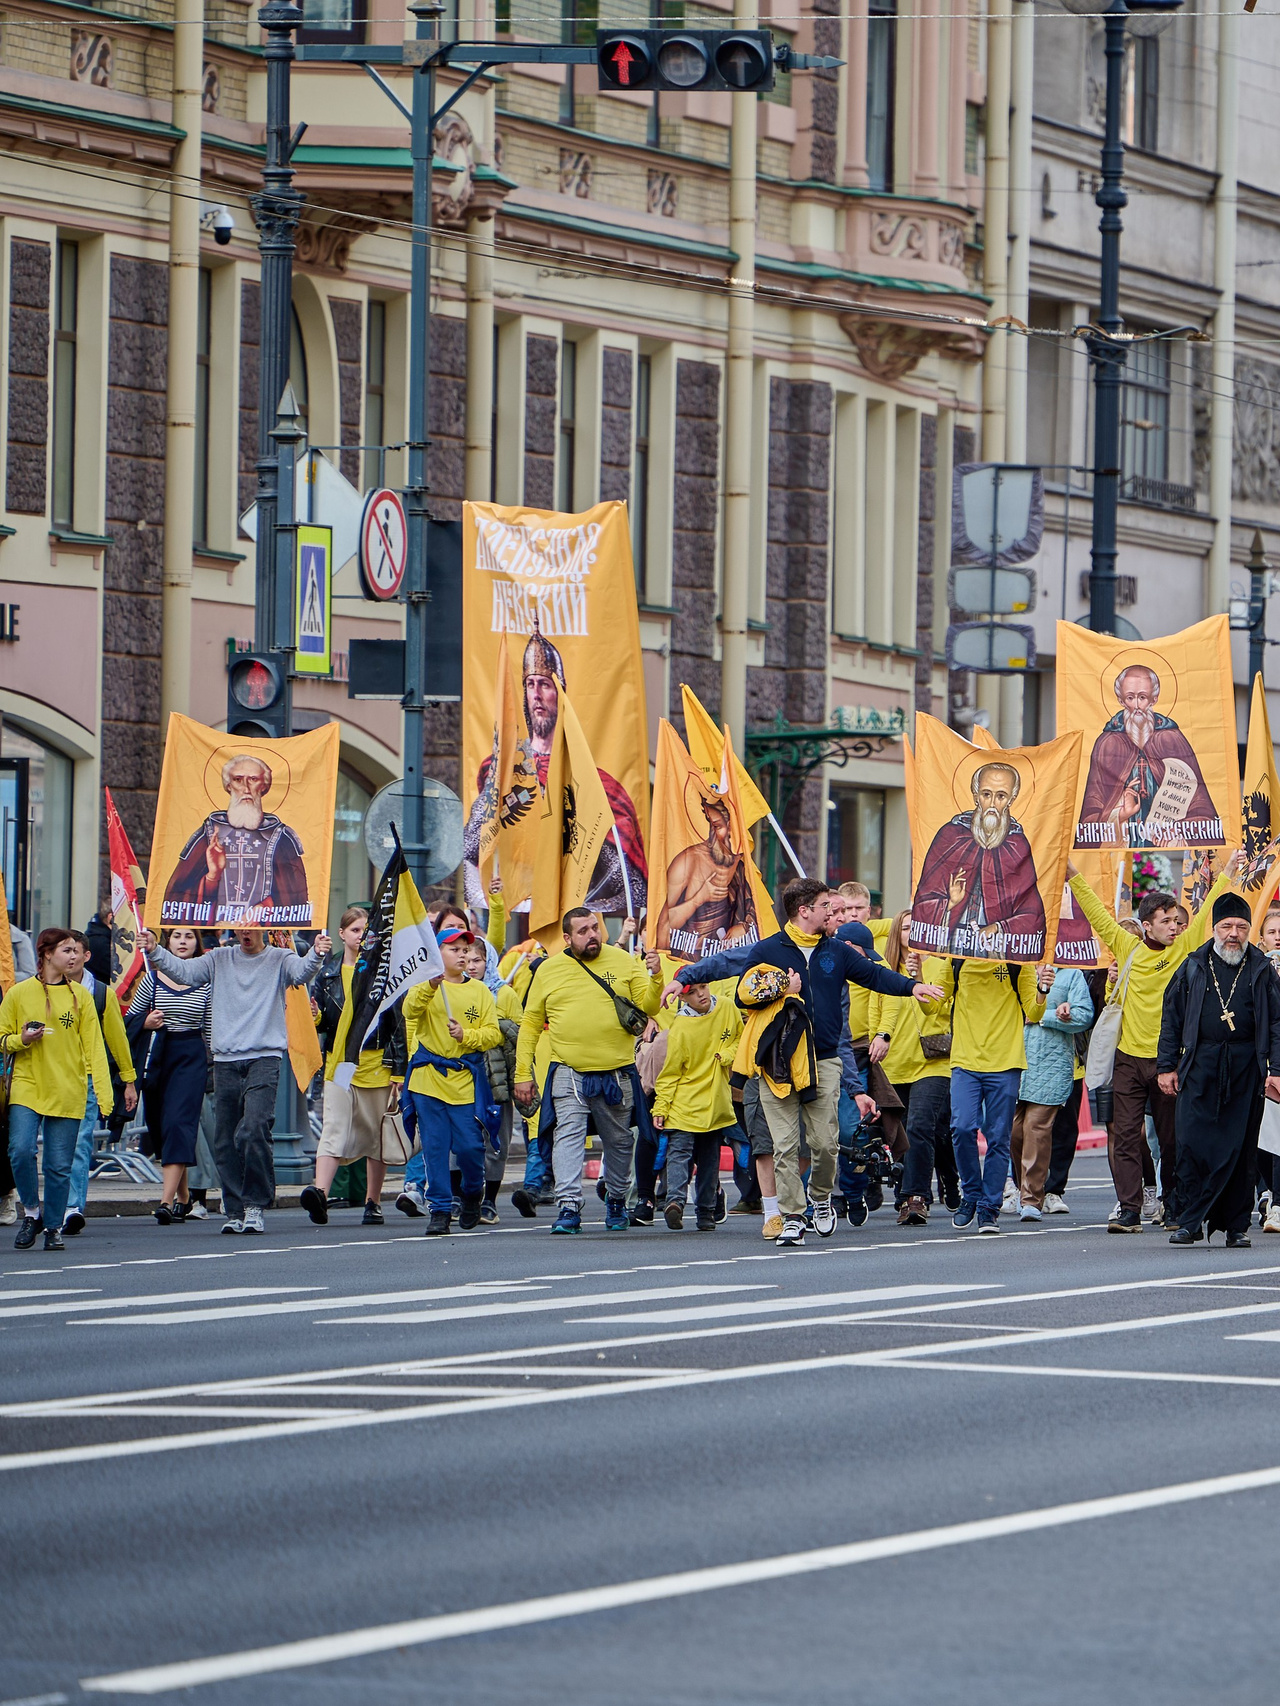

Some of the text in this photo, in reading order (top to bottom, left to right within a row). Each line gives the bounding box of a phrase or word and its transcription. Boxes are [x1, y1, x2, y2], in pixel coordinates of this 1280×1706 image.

[491, 573, 589, 636] НЕВСКИЙ
[1076, 820, 1116, 843] САВВА
[1122, 816, 1224, 843] СТОРОЖЕВСКИЙ
[161, 900, 314, 924] СЕРГИЙ РАДОНЕЖСКИЙ
